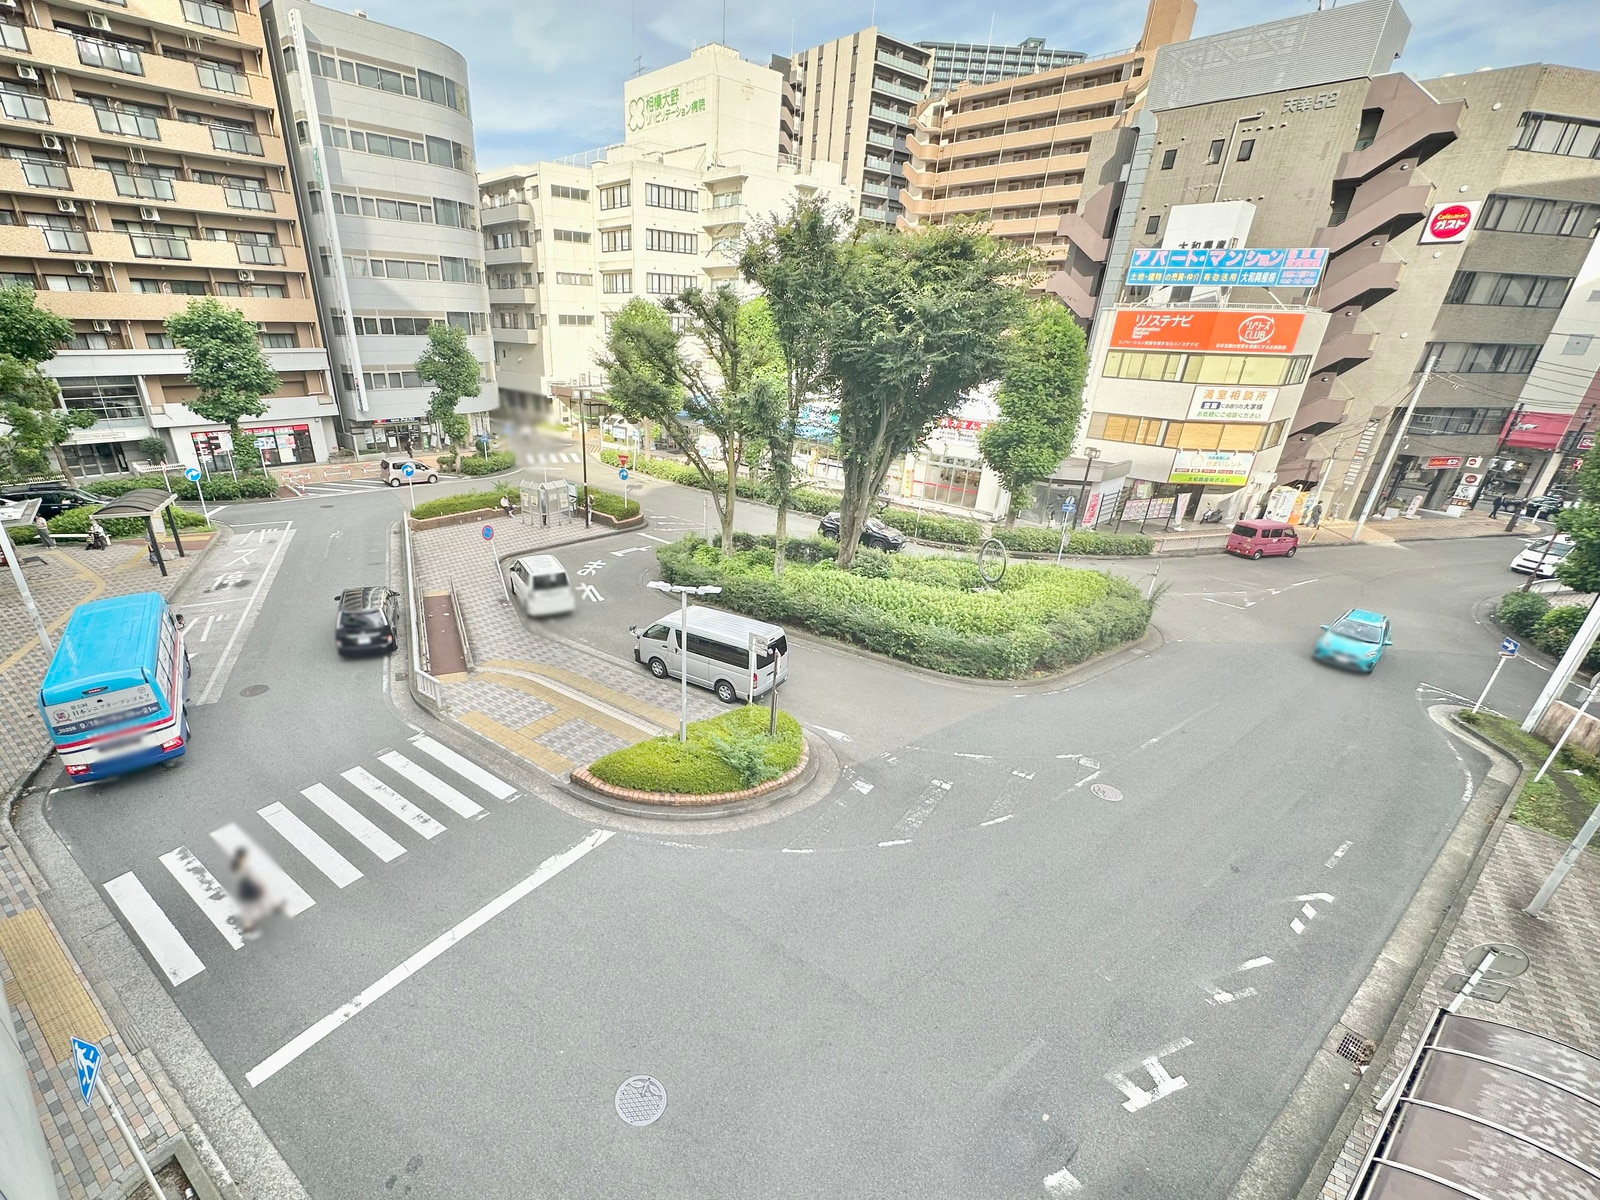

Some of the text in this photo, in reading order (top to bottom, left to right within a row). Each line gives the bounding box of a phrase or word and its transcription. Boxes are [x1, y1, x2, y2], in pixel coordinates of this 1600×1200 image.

[1433, 219, 1466, 230] ガスト
[1134, 249, 1285, 267] アパート・マンション
[1135, 314, 1195, 327] リノステナビ
[1244, 330, 1266, 340] CLUB
[1202, 389, 1268, 401] 満室相談所
